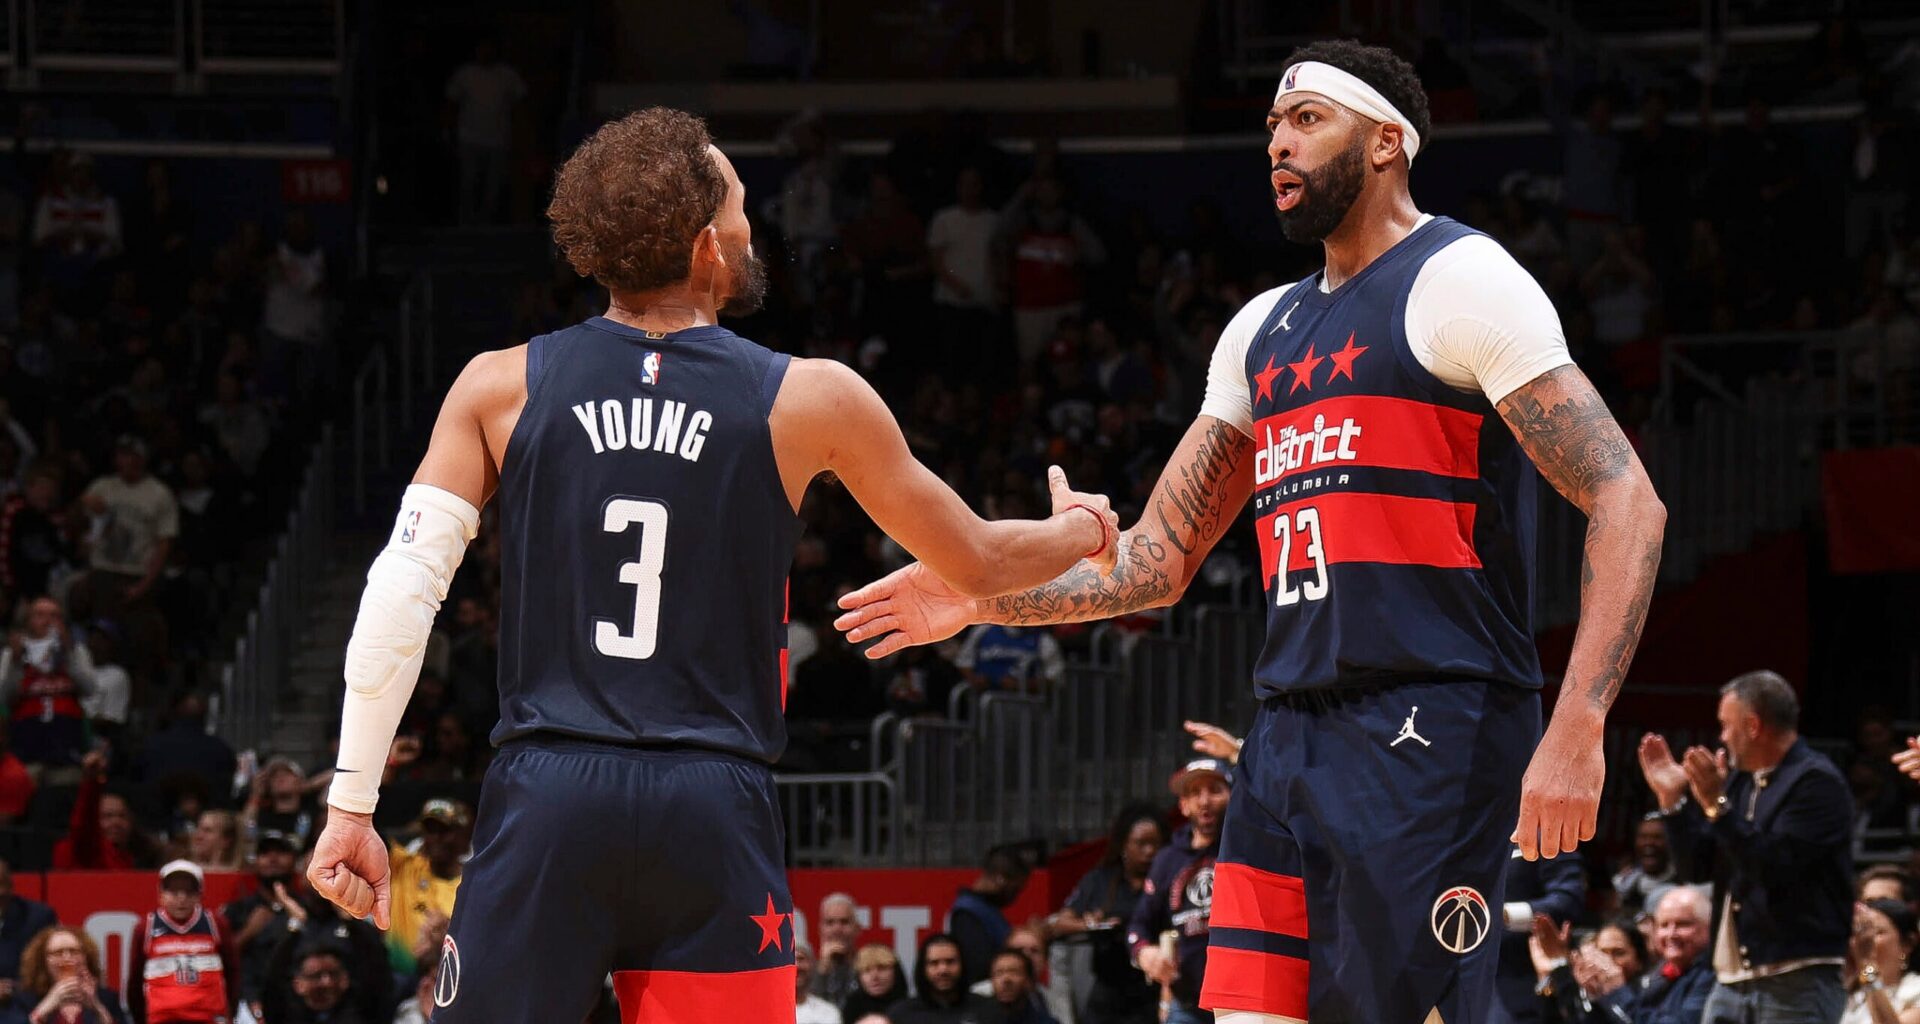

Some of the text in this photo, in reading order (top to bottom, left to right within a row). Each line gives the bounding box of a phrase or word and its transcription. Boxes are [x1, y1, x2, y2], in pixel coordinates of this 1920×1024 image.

[571, 397, 713, 463] YOUNG
[1256, 474, 1350, 509] OF CLUMBIA
[595, 499, 668, 660] 3
[1274, 507, 1329, 607] 23
